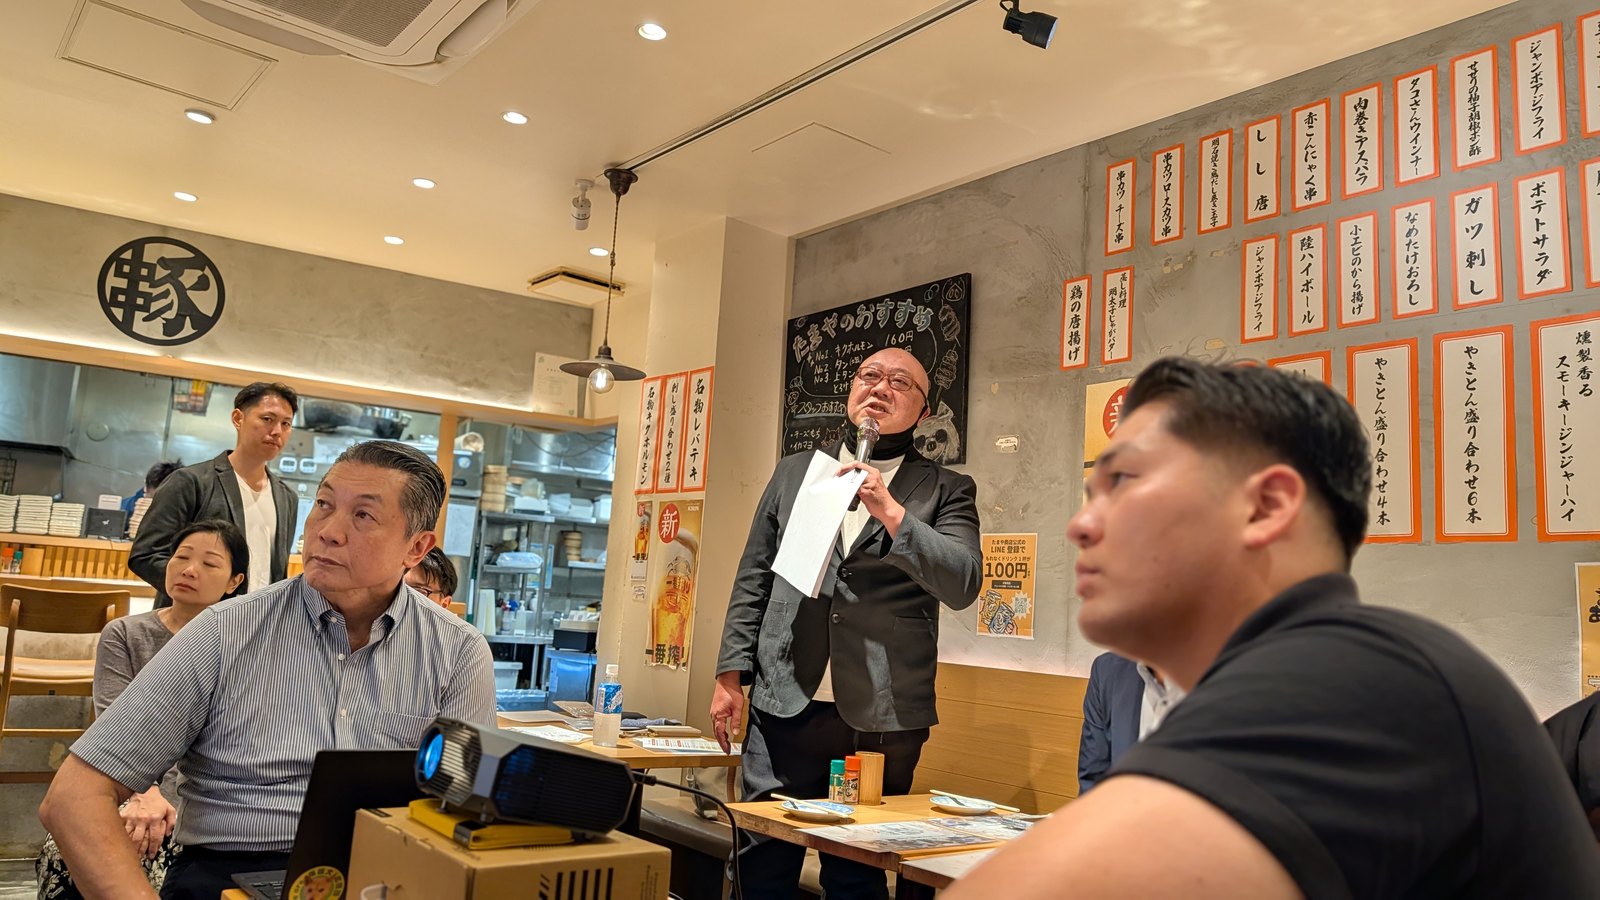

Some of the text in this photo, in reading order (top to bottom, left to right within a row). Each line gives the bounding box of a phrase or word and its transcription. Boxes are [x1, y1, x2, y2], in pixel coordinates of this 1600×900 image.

[1409, 77, 1422, 175] タコさんウインナー
[1529, 40, 1545, 140] ジャンボアジフライ
[1254, 129, 1269, 211] しし唐
[1303, 111, 1318, 201] 赤こんにゃく串
[1353, 97, 1369, 186] 肉巻きアスパラ
[1349, 224, 1364, 315] 小エビのから揚げ
[1405, 212, 1420, 306] なめたけおろし
[1464, 196, 1486, 295] ガツ刺し
[1529, 181, 1553, 285] ポテトサラダ
[792, 298, 934, 364] たまやのおすすめ
[1067, 284, 1083, 362] 鶏の唐揚げ
[1253, 245, 1265, 332] ジャンボアジフライ
[884, 330, 914, 347] 160円
[1575, 330, 1594, 397] 燻製香る
[640, 386, 655, 485] 名物キクホルモン
[689, 378, 705, 481] 名物レバテキ
[1373, 357, 1391, 526] やきとん盛り合わせ4本
[1463, 345, 1482, 524] やきとん盛り合わせ6本
[1555, 354, 1577, 522] スモーキージンジャーハイ
[660, 509, 678, 539] 新
[984, 562, 1028, 578] 100円
